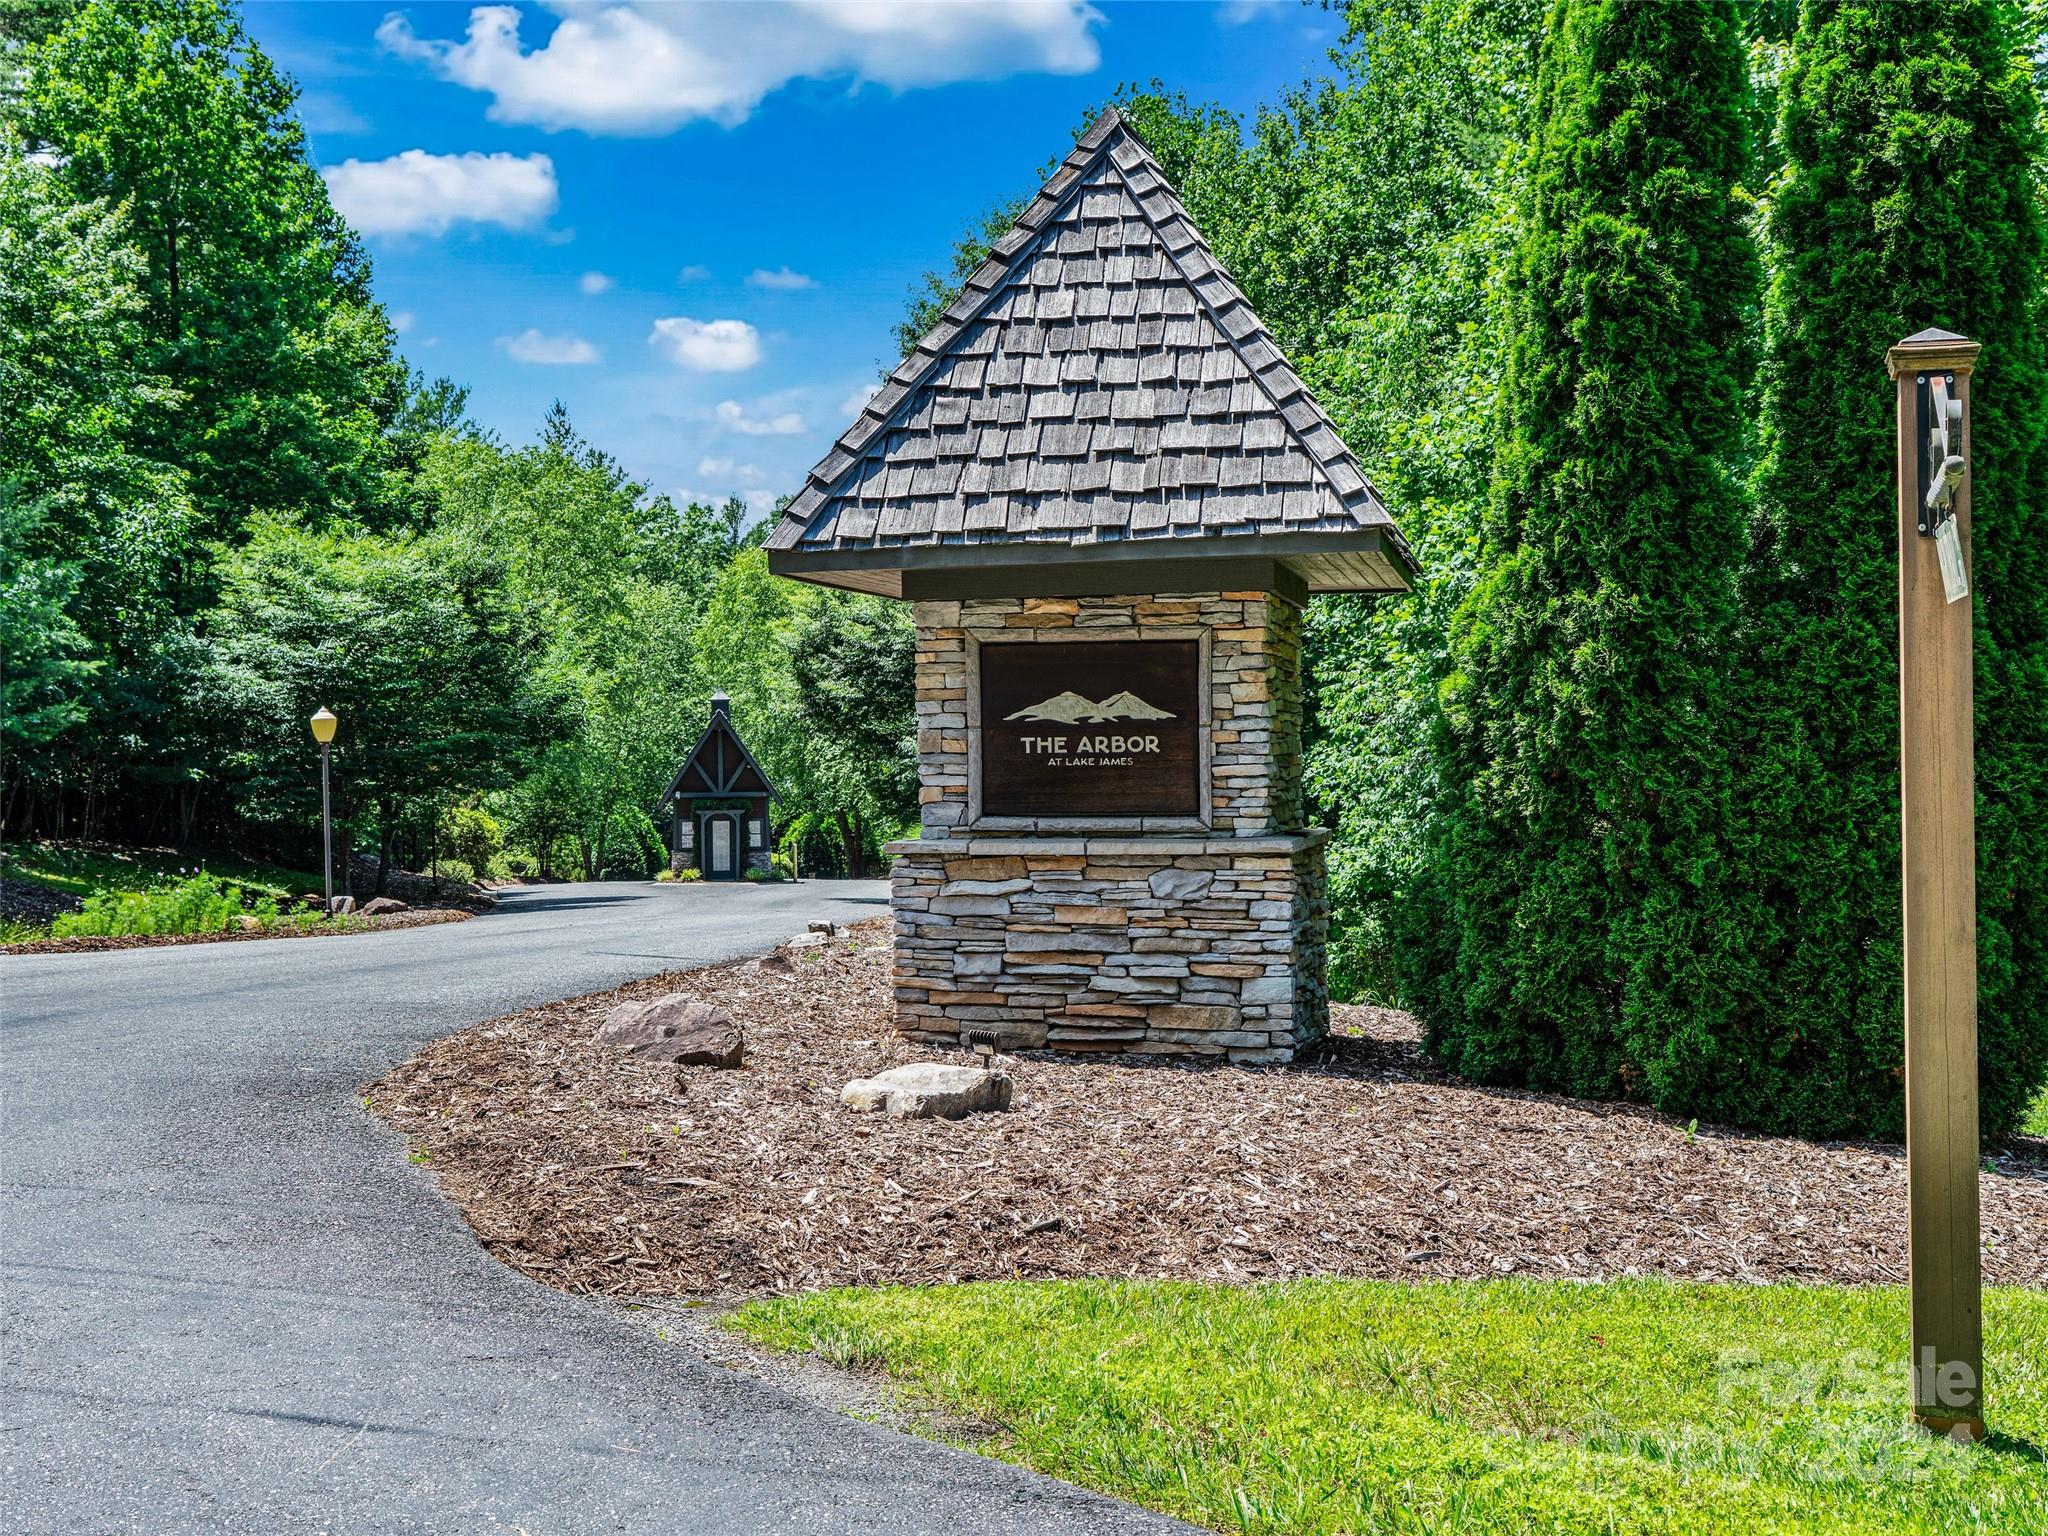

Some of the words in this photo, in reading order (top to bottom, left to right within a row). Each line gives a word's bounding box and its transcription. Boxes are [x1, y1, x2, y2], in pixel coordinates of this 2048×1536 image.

[1020, 737, 1067, 753] THE
[1076, 735, 1160, 754] ARBOR
[1048, 758, 1061, 766] AT
[1065, 758, 1095, 766] LAKE
[1099, 758, 1134, 766] JAMES
